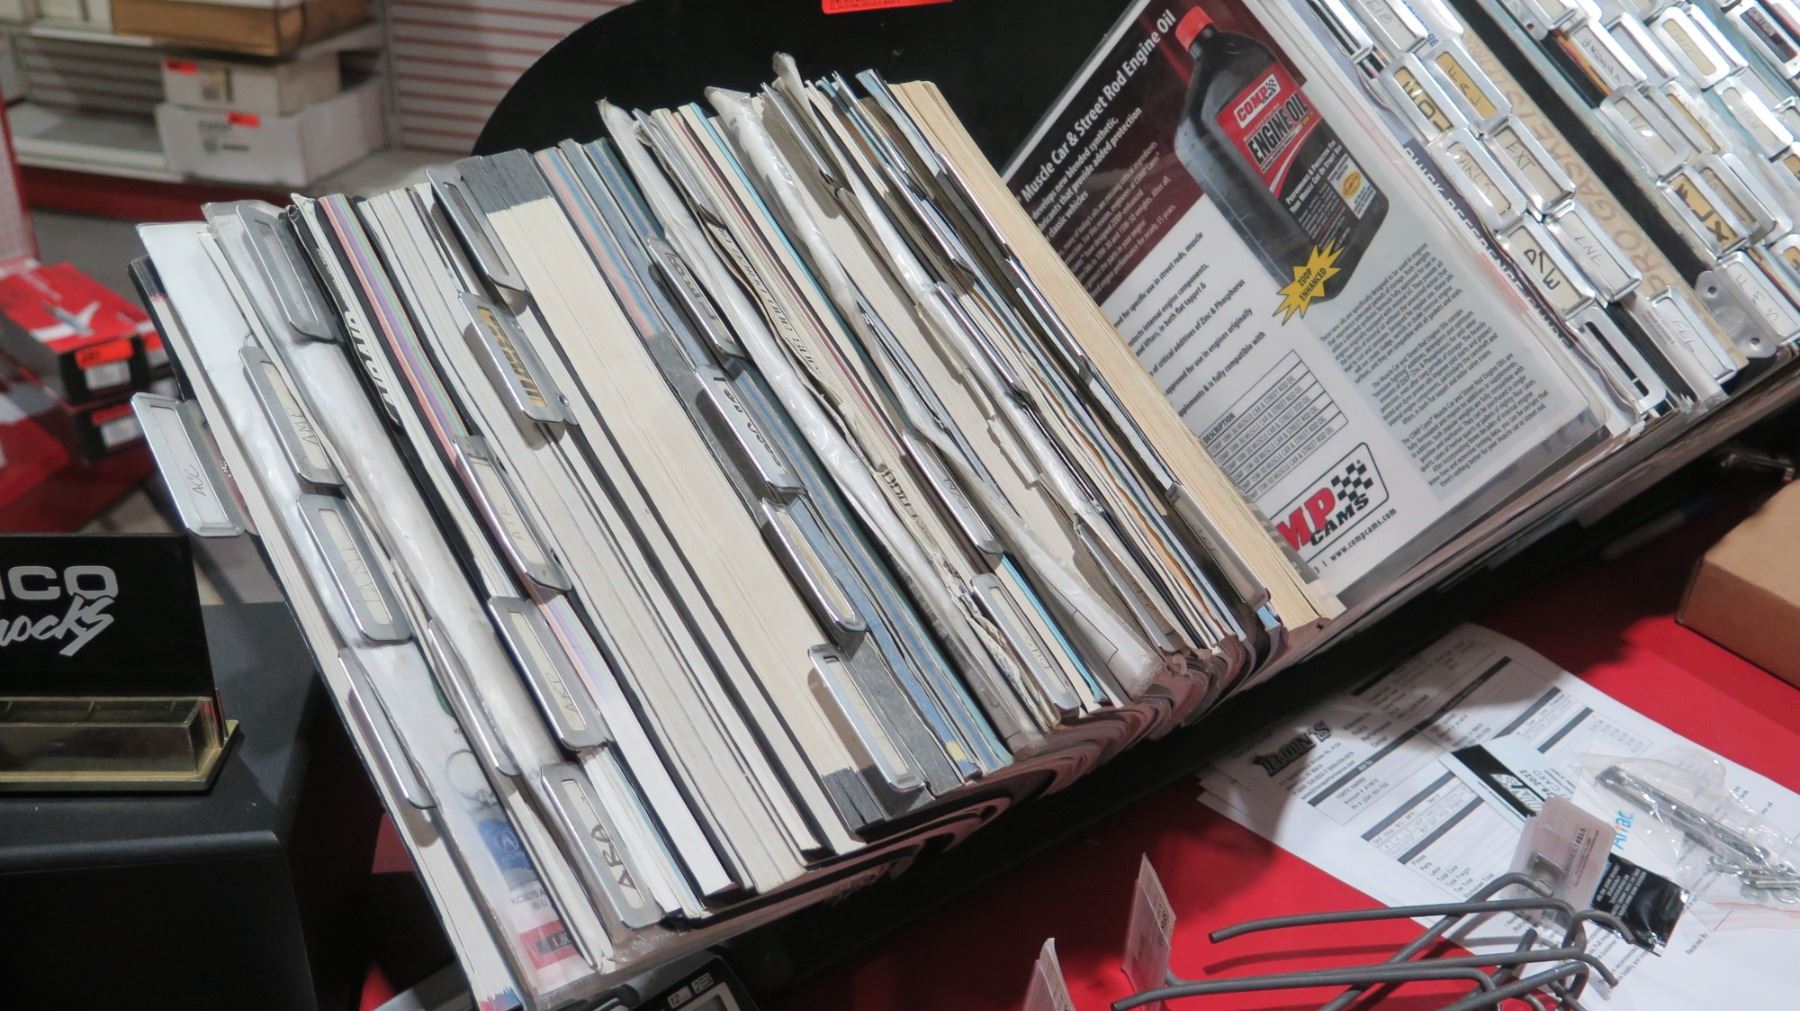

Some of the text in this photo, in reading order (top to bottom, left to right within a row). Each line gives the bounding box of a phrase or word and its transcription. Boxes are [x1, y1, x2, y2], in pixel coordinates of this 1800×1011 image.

[1017, 7, 1179, 203] Muscle Car & Street Rod Engine Oil
[1234, 84, 1272, 122] COMP
[1243, 106, 1297, 165] ENGINE
[1281, 91, 1310, 123] OIL
[1053, 175, 1071, 194] new
[1064, 147, 1093, 179] blended
[1086, 113, 1121, 153] synthetic,
[1057, 104, 1145, 206] that provide added protection
[1505, 141, 1536, 170] EXT
[1045, 188, 1090, 238] classic vehicles
[1120, 229, 1204, 319] for specific use in street rods, muscle
[1140, 260, 1211, 332] internal engine components,
[1299, 266, 1328, 302] ENHANCED
[1132, 280, 1208, 358] and lifters, in both flat tappet &
[1150, 277, 1248, 374] of critical additives of Zinc & Phosphorus
[1163, 305, 1255, 397] approved for use in engines originally
[1201, 329, 1267, 393] & is fully compatible with
[1201, 410, 1236, 445] DESCRIPTION
[1306, 490, 1372, 548] CAMS
[1328, 506, 1399, 563] www.compcams.com
